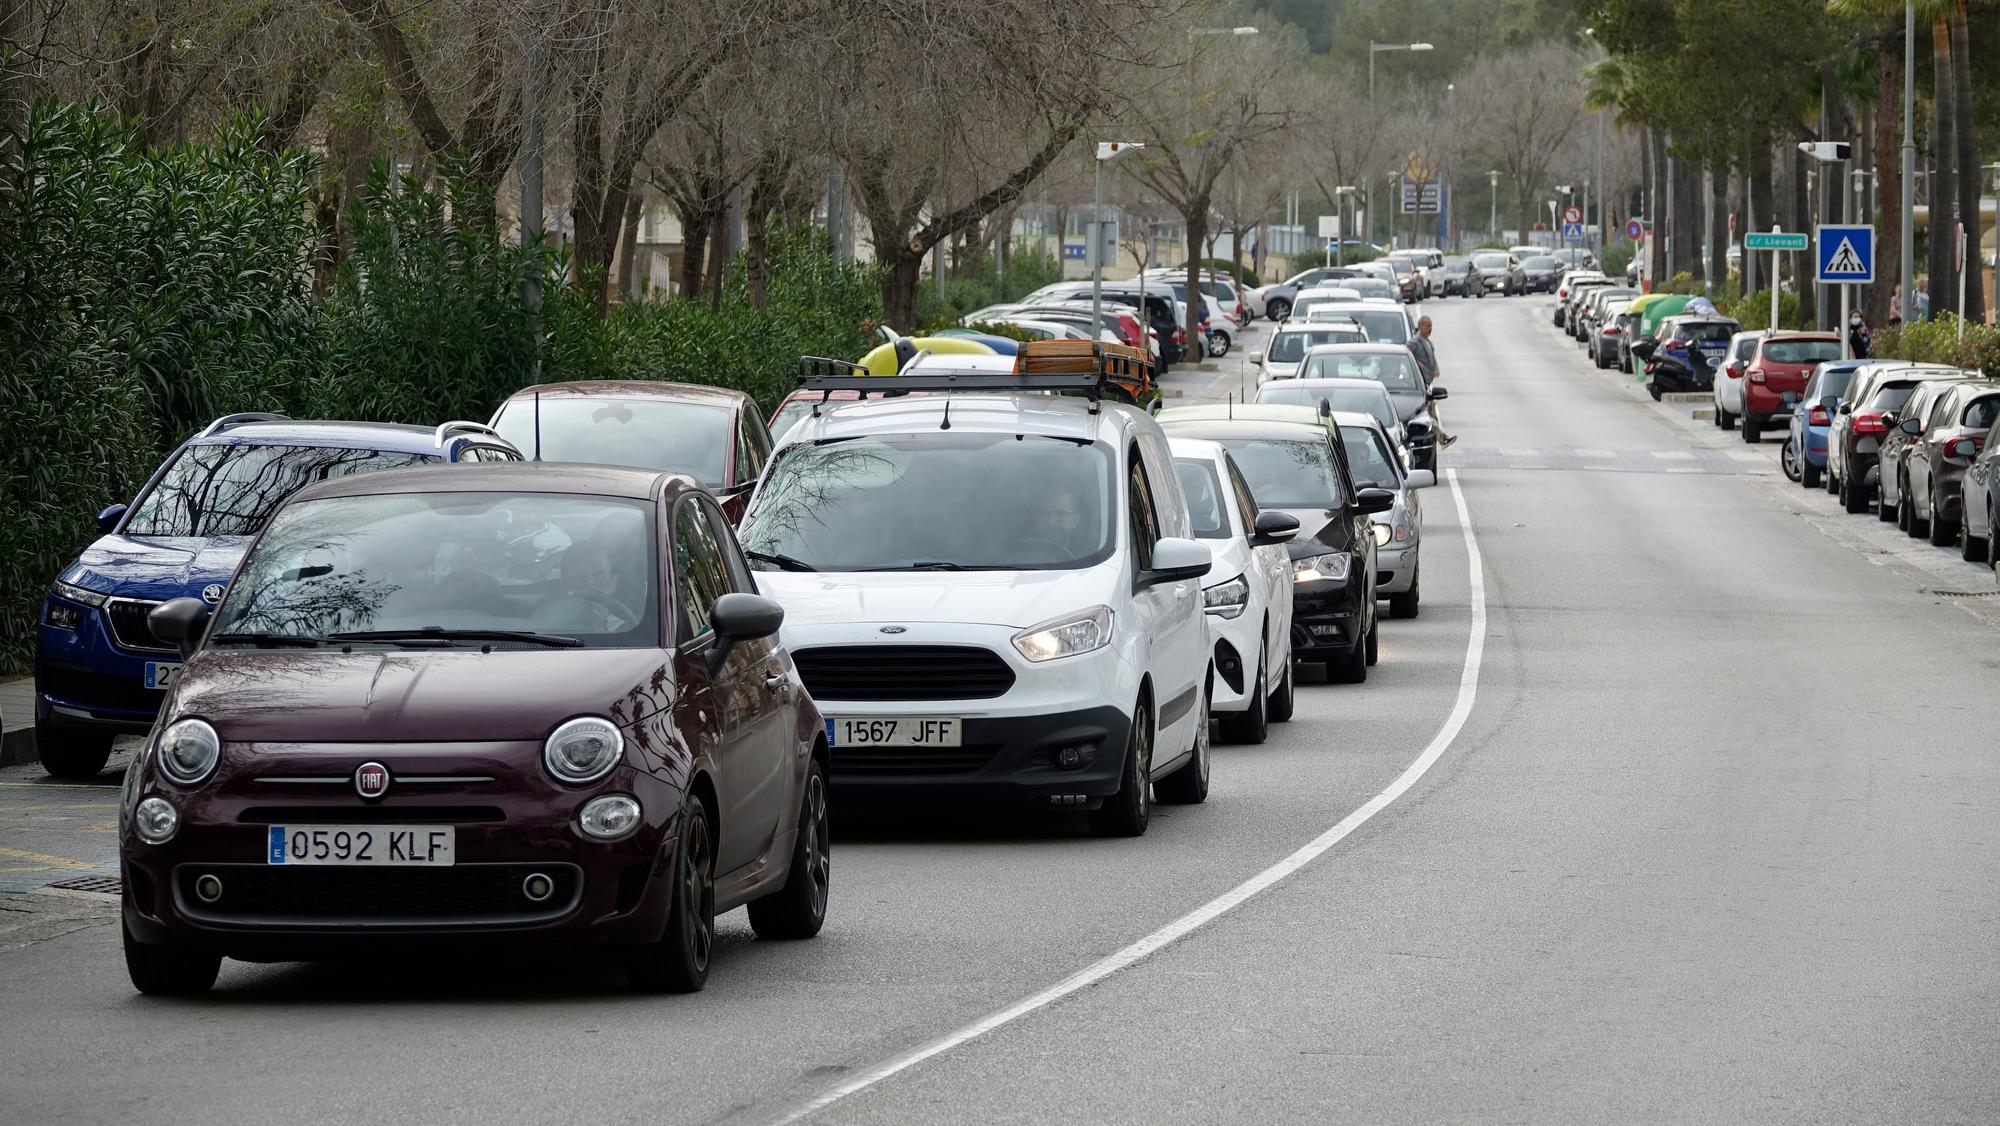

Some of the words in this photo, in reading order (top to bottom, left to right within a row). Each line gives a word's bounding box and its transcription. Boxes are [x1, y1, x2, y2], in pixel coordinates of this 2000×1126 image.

[1765, 237, 1803, 246] Llevant
[845, 720, 898, 743] 1567
[912, 720, 952, 743] JFF
[361, 772, 382, 789] FIAT
[273, 848, 281, 858] E
[291, 830, 373, 860] 0592
[389, 831, 447, 861] KLF
